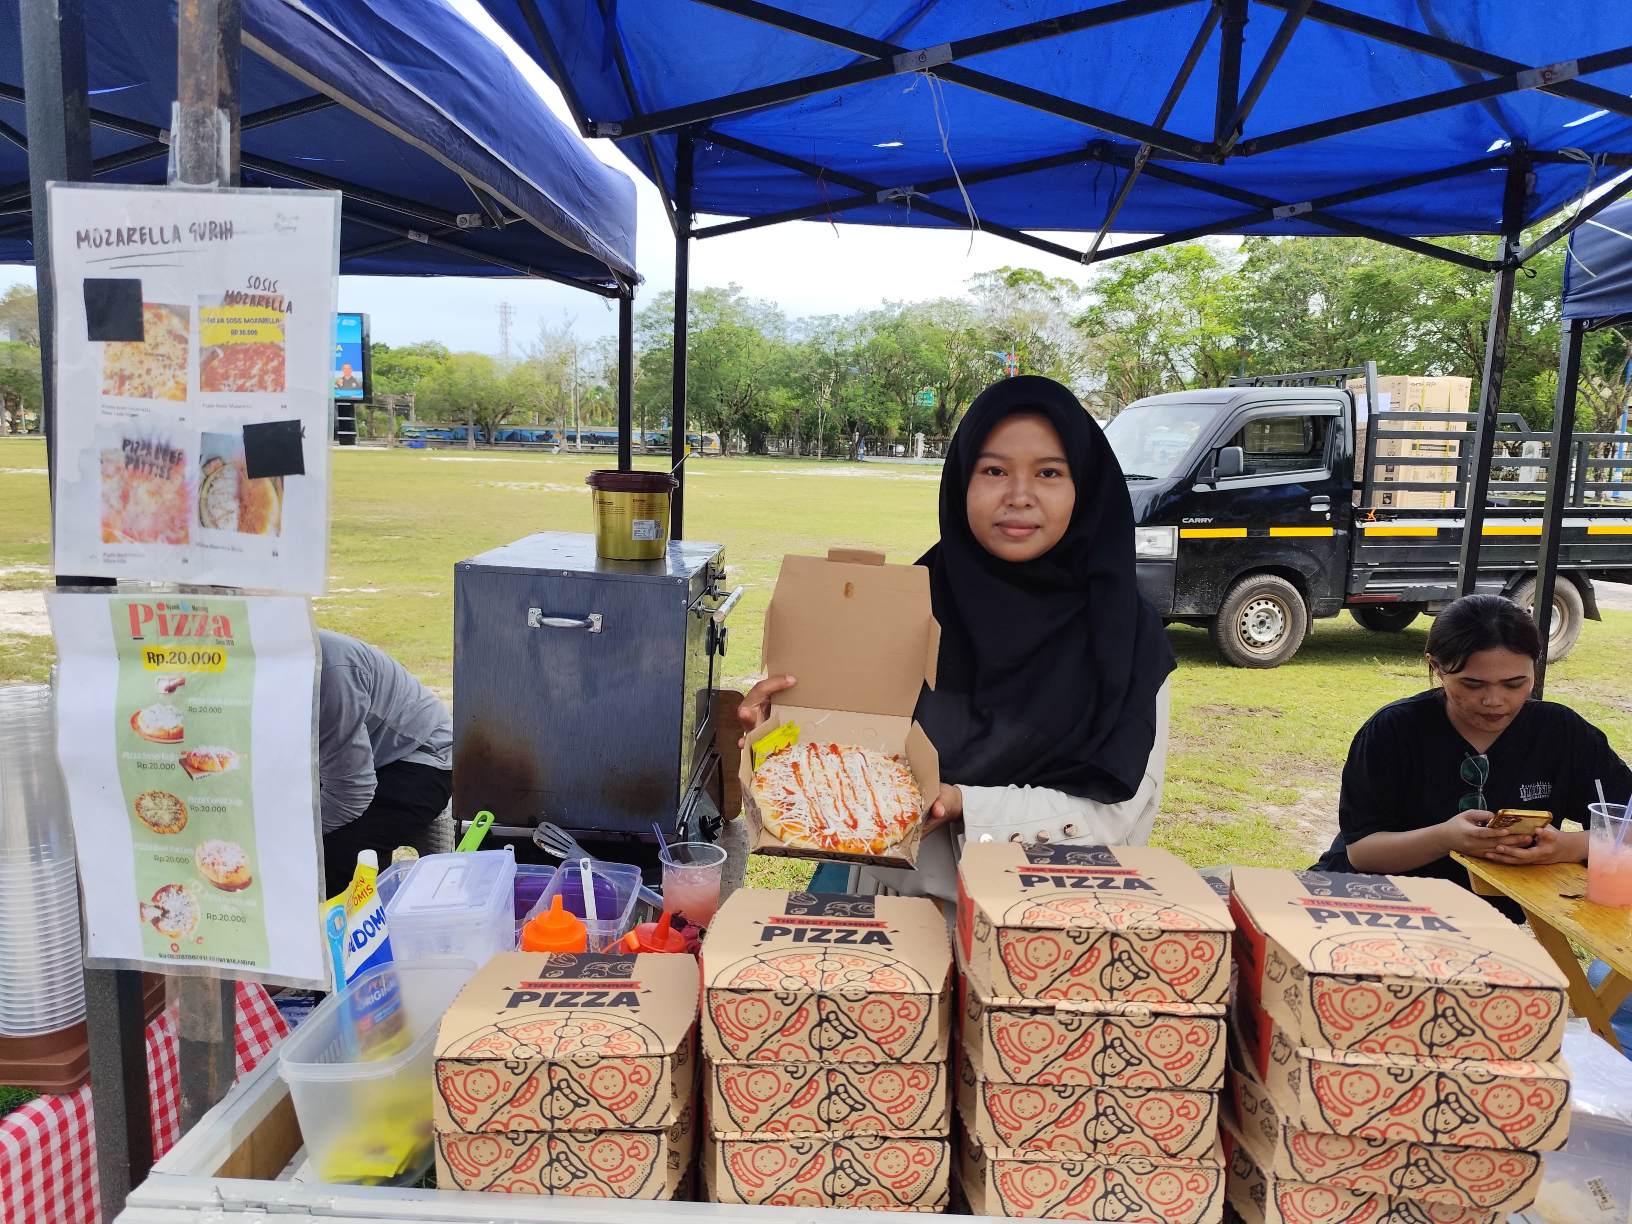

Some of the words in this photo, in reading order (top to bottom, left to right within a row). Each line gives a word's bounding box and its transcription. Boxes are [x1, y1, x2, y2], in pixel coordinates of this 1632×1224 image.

[76, 222, 182, 249] MOZARELLA
[247, 275, 279, 293] SOSIS
[223, 289, 293, 314] MOZARELLA
[127, 602, 234, 638] Pizza
[146, 651, 222, 667] Rp.20.000
[1018, 874, 1157, 890] PIZZA
[1305, 907, 1463, 932] PIZZA
[760, 926, 893, 945] PIZZA
[505, 991, 640, 1008] PIZZA
